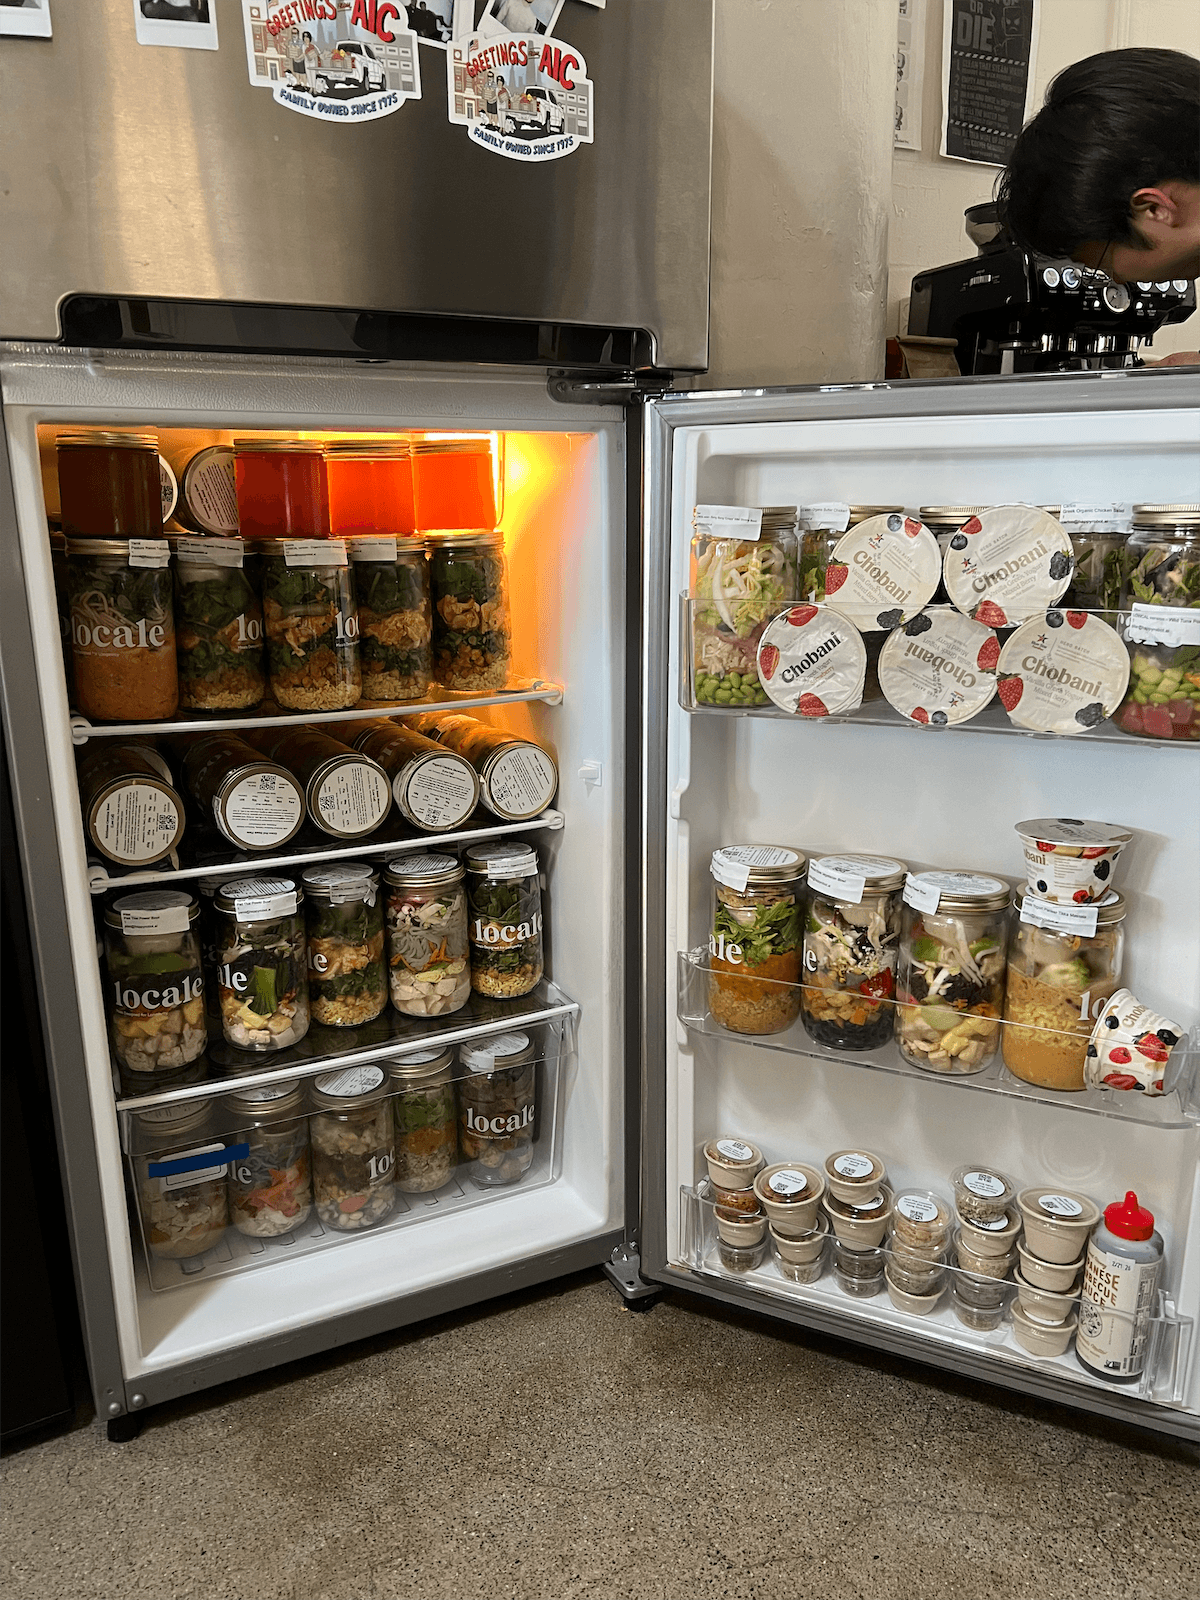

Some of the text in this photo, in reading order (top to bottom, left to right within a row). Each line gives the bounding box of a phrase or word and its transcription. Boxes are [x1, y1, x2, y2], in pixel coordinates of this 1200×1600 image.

[265, 0, 337, 36] GREETINGS
[351, 0, 401, 43] AIC
[969, 0, 983, 15] OR
[957, 11, 994, 53] DIE
[466, 40, 528, 78] GREETINGS
[538, 43, 580, 90] AIC
[280, 88, 398, 116] FAMILY OWNED SINCE 1975
[473, 126, 574, 155] FAMILY OWNED SINCE 1975
[853, 550, 912, 604] Chobani
[972, 540, 1049, 593] Chobani
[72, 617, 166, 648] locale
[921, 636, 941, 651] Yogurt
[781, 631, 842, 683] Chobani
[904, 642, 977, 688] Chobani
[1022, 655, 1102, 698] Chobani
[1024, 848, 1046, 866] bani
[475, 912, 543, 943] locale
[709, 933, 742, 964] ale
[114, 975, 203, 1010] locale
[1122, 1004, 1147, 1028] Chob
[466, 1104, 535, 1134] locale
[1086, 1256, 1121, 1292] PANESE
[1083, 1283, 1107, 1311] AUCE
